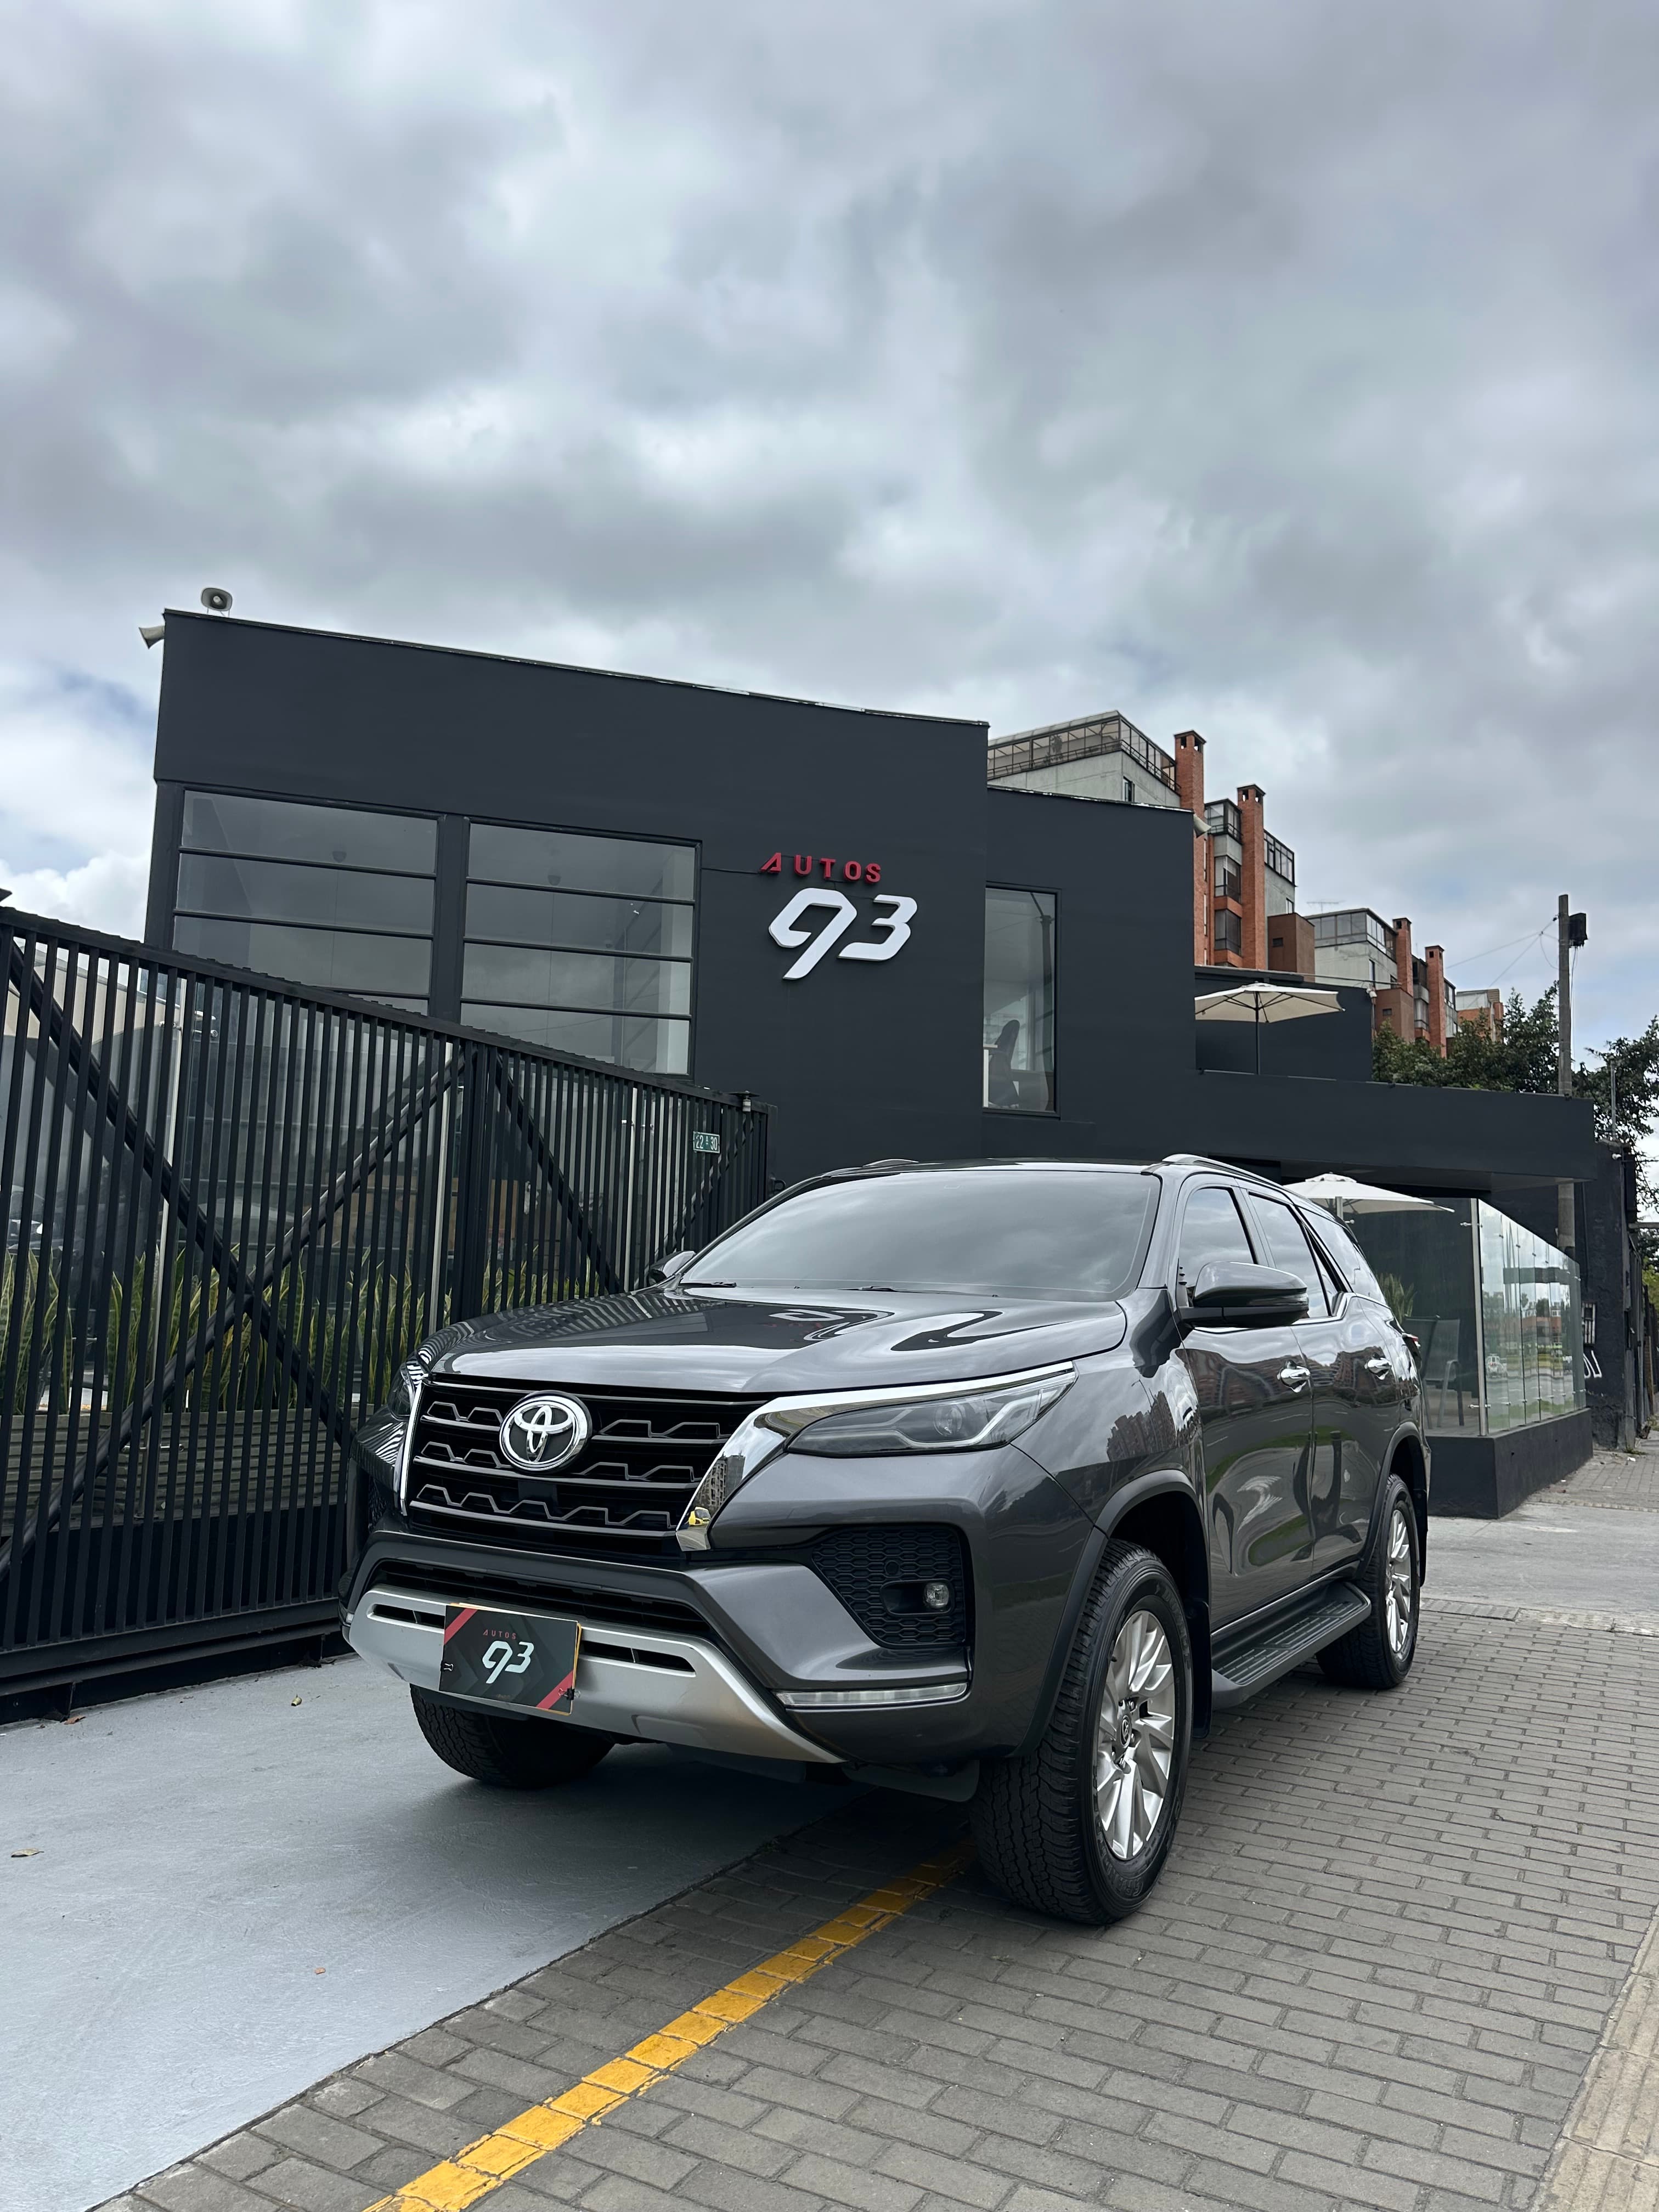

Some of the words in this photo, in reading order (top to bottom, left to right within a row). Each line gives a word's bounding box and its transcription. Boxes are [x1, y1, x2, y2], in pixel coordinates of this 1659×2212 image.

[760, 852, 881, 883] AUTOS
[768, 887, 918, 980] 93
[483, 1629, 517, 1640] AUTOS
[482, 1640, 534, 1684] 93
